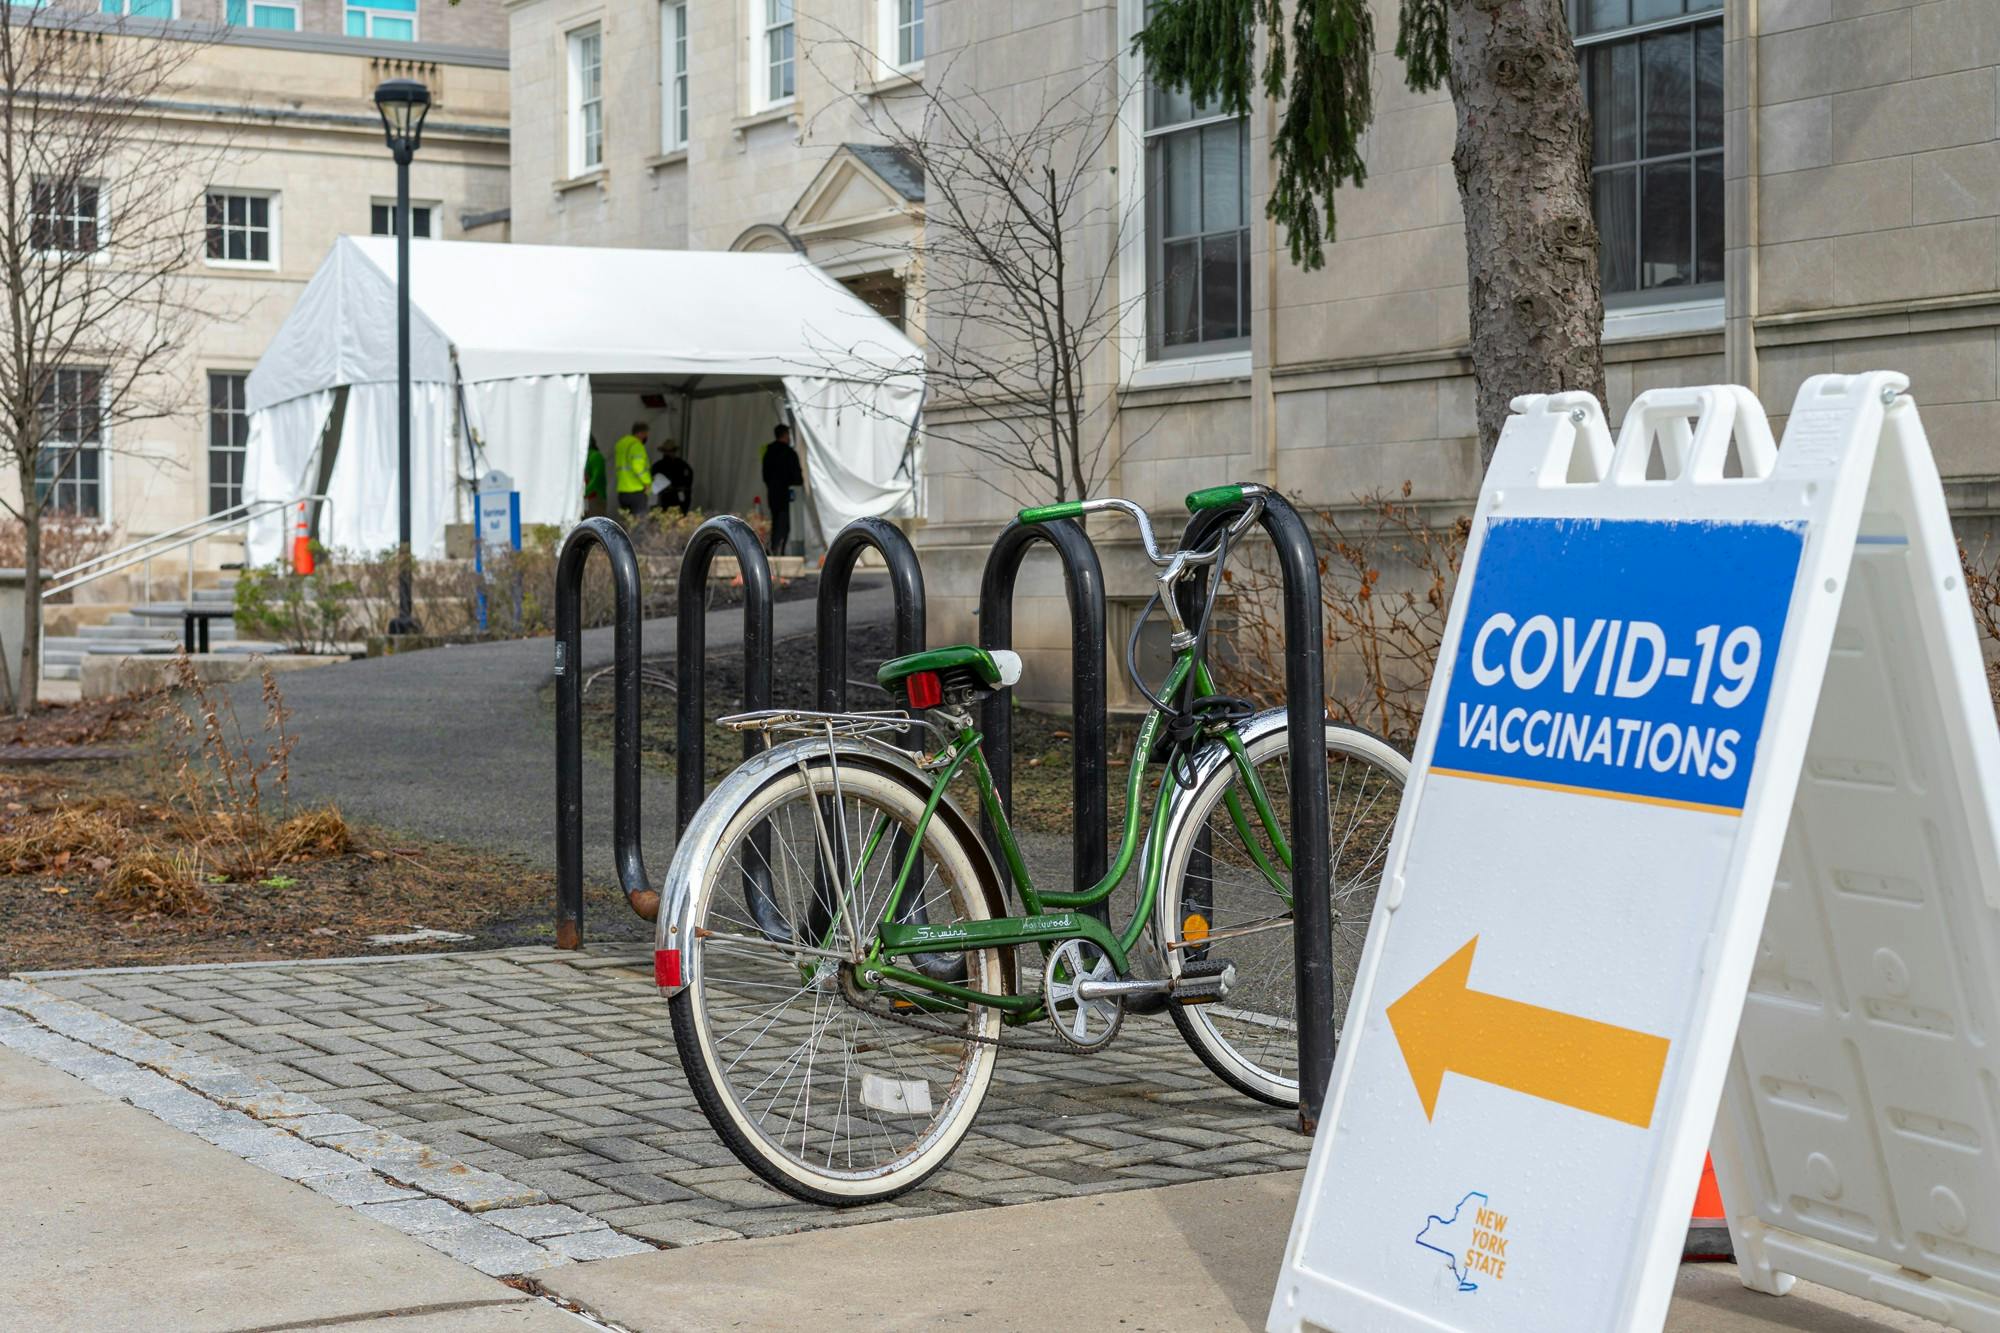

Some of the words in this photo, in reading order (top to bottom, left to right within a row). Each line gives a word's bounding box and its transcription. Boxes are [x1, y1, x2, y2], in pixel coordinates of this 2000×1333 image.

[1471, 612, 1762, 709] COVID-19
[1457, 702, 1742, 781] VACCINATIONS
[1476, 1208, 1508, 1232] NEW
[1473, 1229, 1508, 1257] YORK
[1466, 1249, 1506, 1279] STATE
